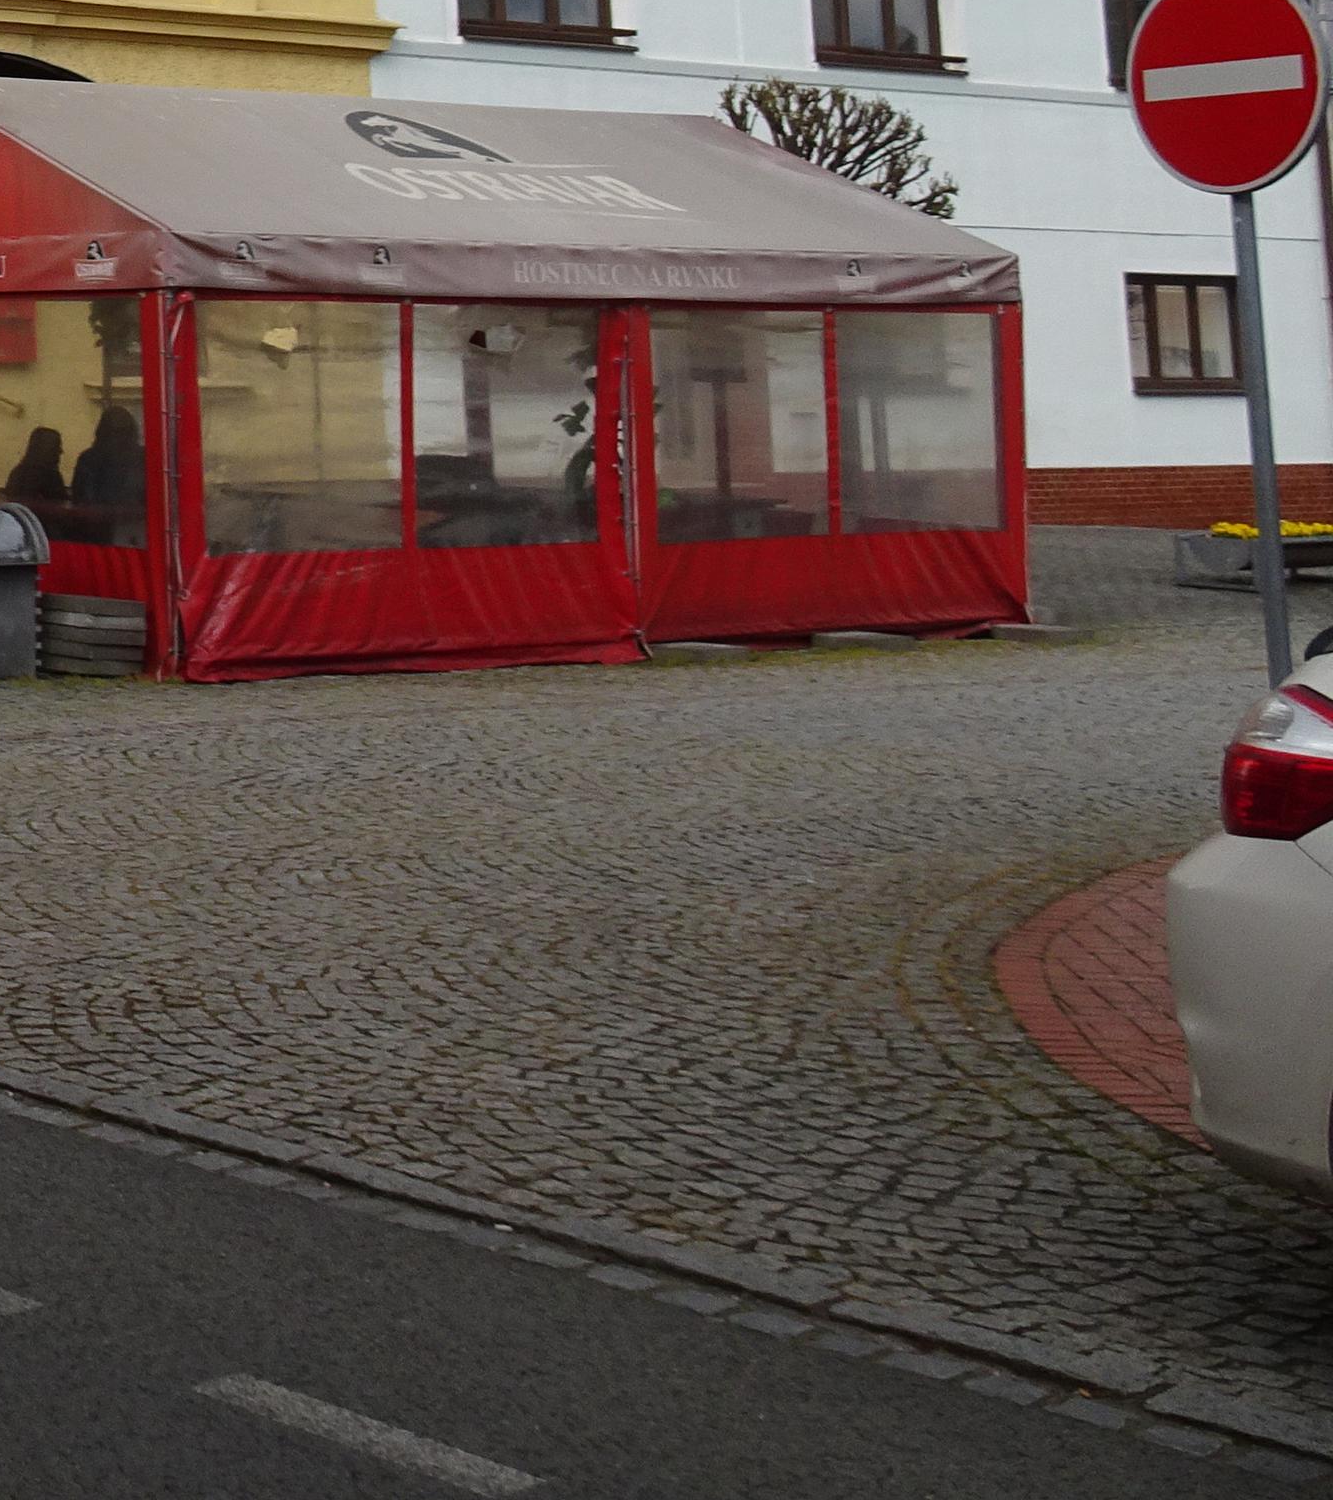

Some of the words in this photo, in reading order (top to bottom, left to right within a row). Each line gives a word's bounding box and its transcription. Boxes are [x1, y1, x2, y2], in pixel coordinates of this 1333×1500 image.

[344, 162, 688, 212] OSTRAVAR
[513, 260, 623, 286] HOSTINEC
[634, 264, 663, 287] NA
[666, 265, 741, 289] RYNKU
